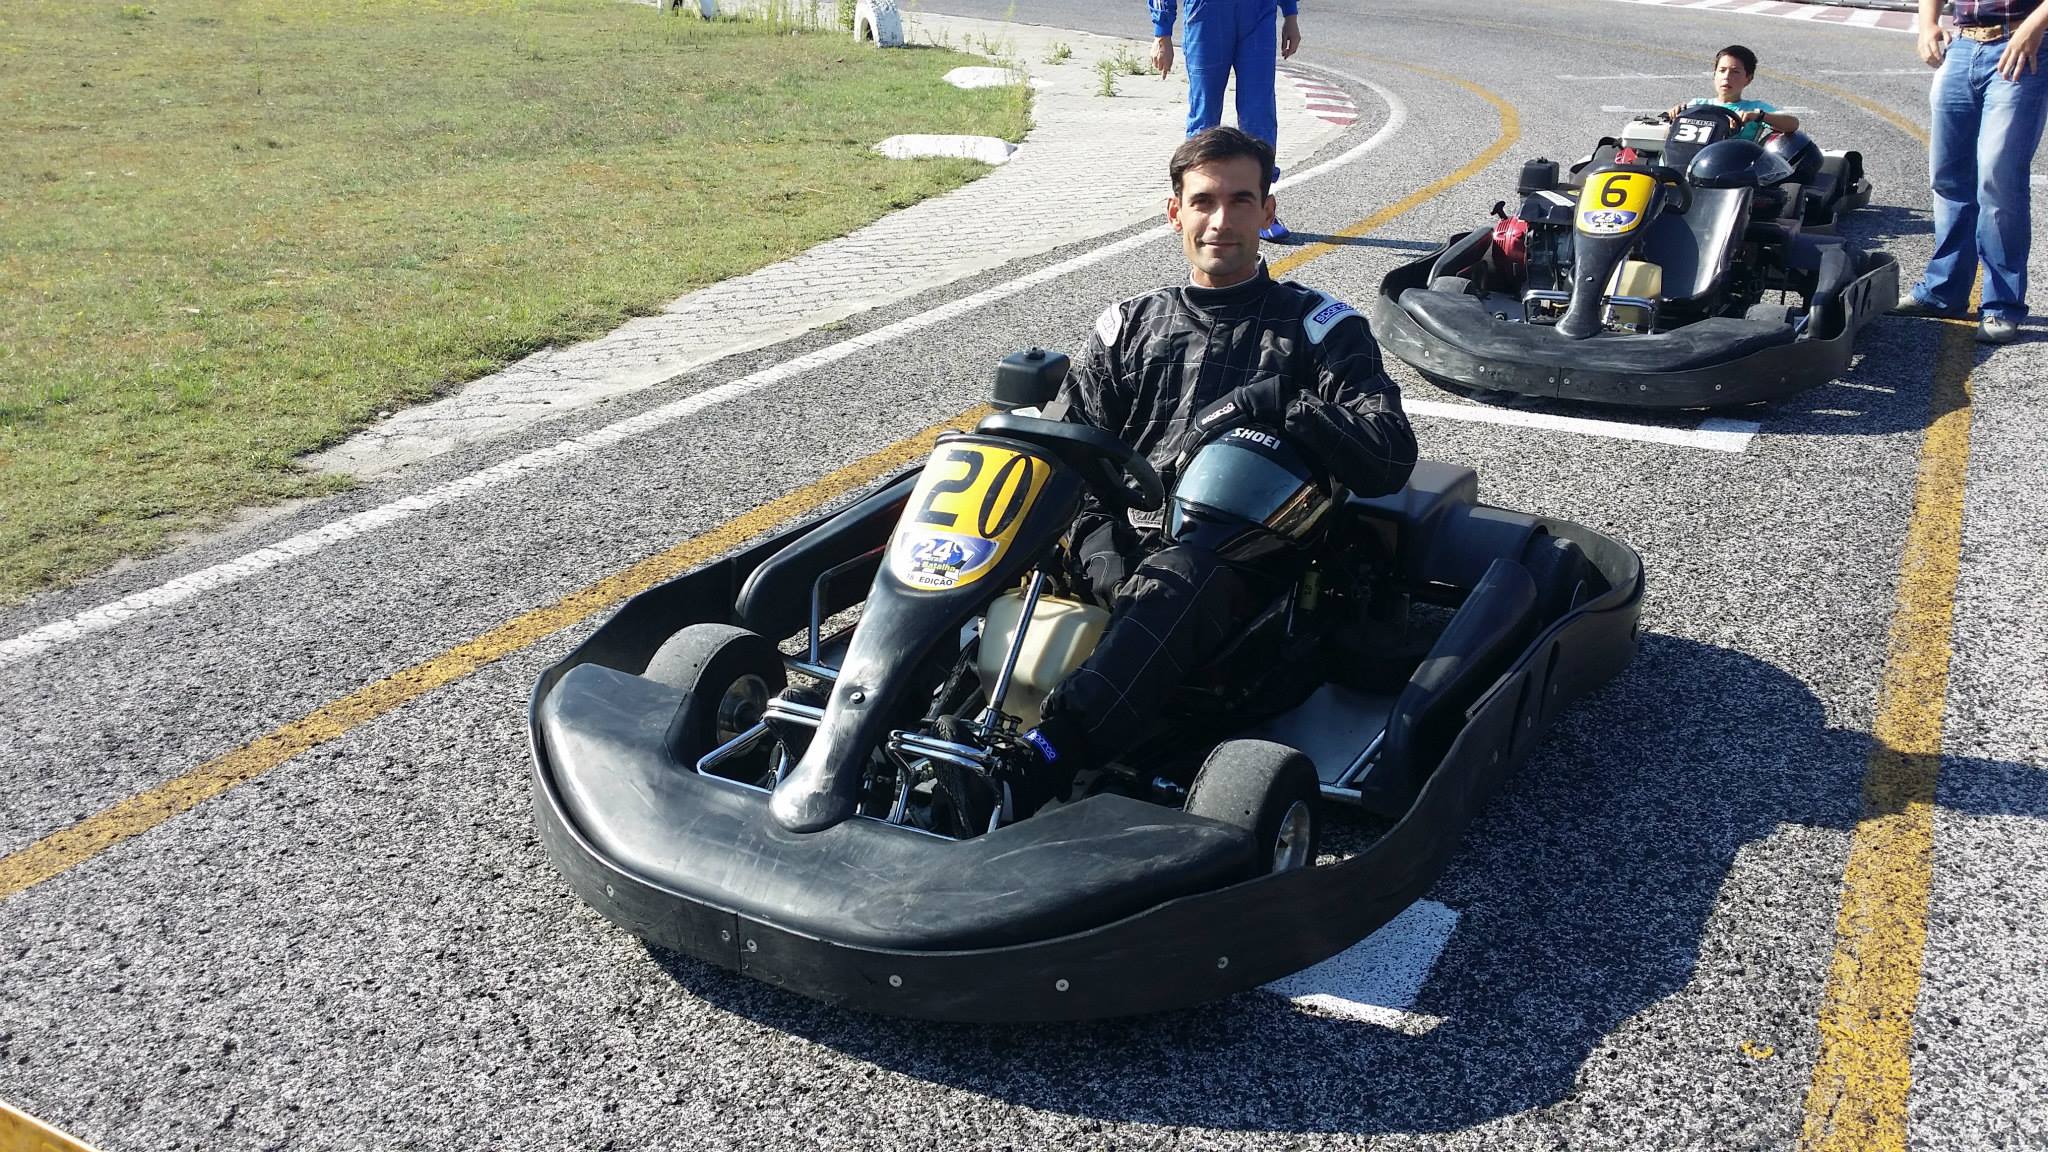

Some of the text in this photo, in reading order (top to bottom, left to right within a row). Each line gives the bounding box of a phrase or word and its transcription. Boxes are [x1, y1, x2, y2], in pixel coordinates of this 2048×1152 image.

[1674, 124, 1713, 143] 31
[1601, 175, 1632, 208] 6
[1230, 427, 1281, 451] SHOEI
[914, 449, 1034, 539] 20
